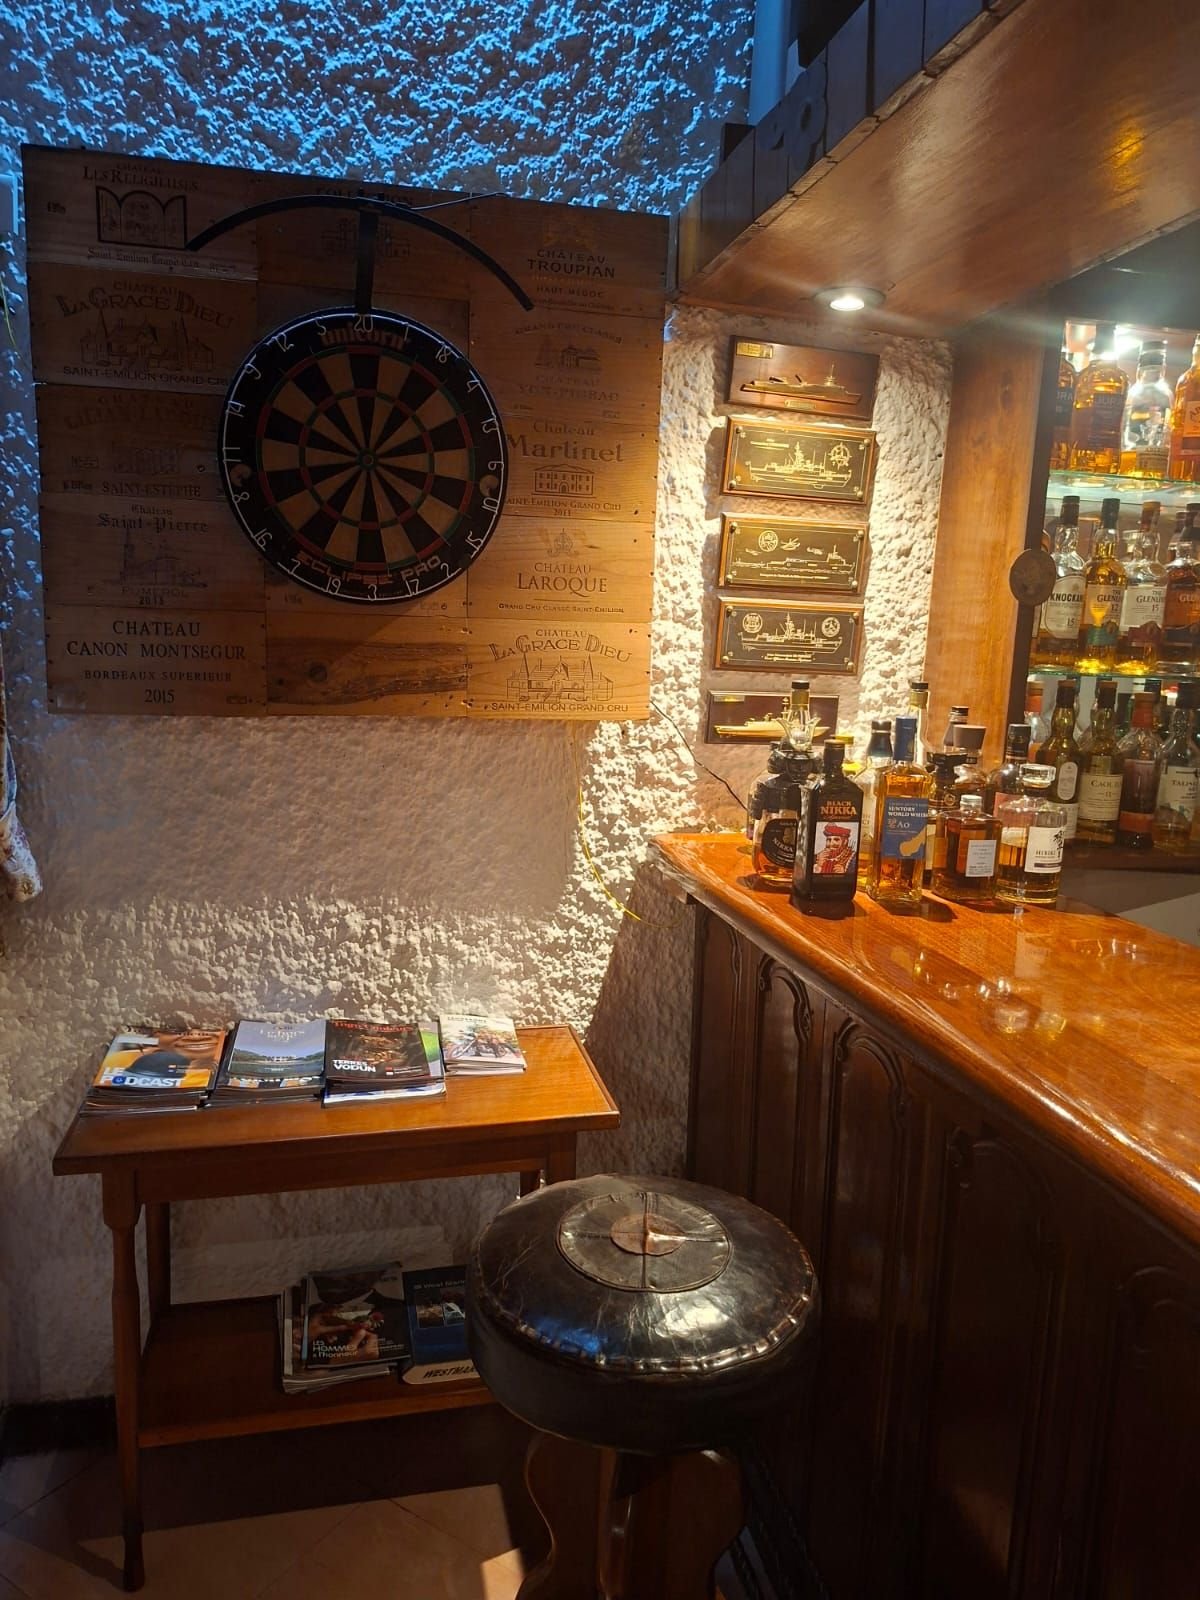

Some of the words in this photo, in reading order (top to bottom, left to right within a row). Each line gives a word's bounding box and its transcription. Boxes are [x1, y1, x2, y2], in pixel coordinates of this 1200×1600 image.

[528, 258, 615, 279] TROUPIAN
[88, 287, 171, 311] GRACE
[176, 290, 236, 329] DIEU
[314, 317, 328, 336] 5
[353, 314, 375, 334] 20
[434, 341, 452, 364] 18
[479, 417, 499, 434] 13
[507, 434, 625, 463] Martinet
[400, 555, 442, 581] PRO
[326, 578, 342, 595] 19
[517, 572, 608, 598] LAROQUE
[112, 620, 201, 637] CHATEAU
[66, 640, 128, 657] CANON
[140, 643, 247, 661] MONTSEGUR
[489, 642, 516, 662] LA
[515, 635, 581, 654] GRACE
[585, 634, 632, 663] DIEU
[84, 669, 158, 682] BORDEAUX
[144, 688, 176, 705] 2015
[491, 702, 566, 713] SAINT-EMILION
[569, 703, 605, 713] GRAND
[607, 703, 629, 713] CRU
[820, 806, 857, 816] NIKKA
[772, 837, 794, 853] NIKKA
[99, 1075, 186, 1088] PODCAST
